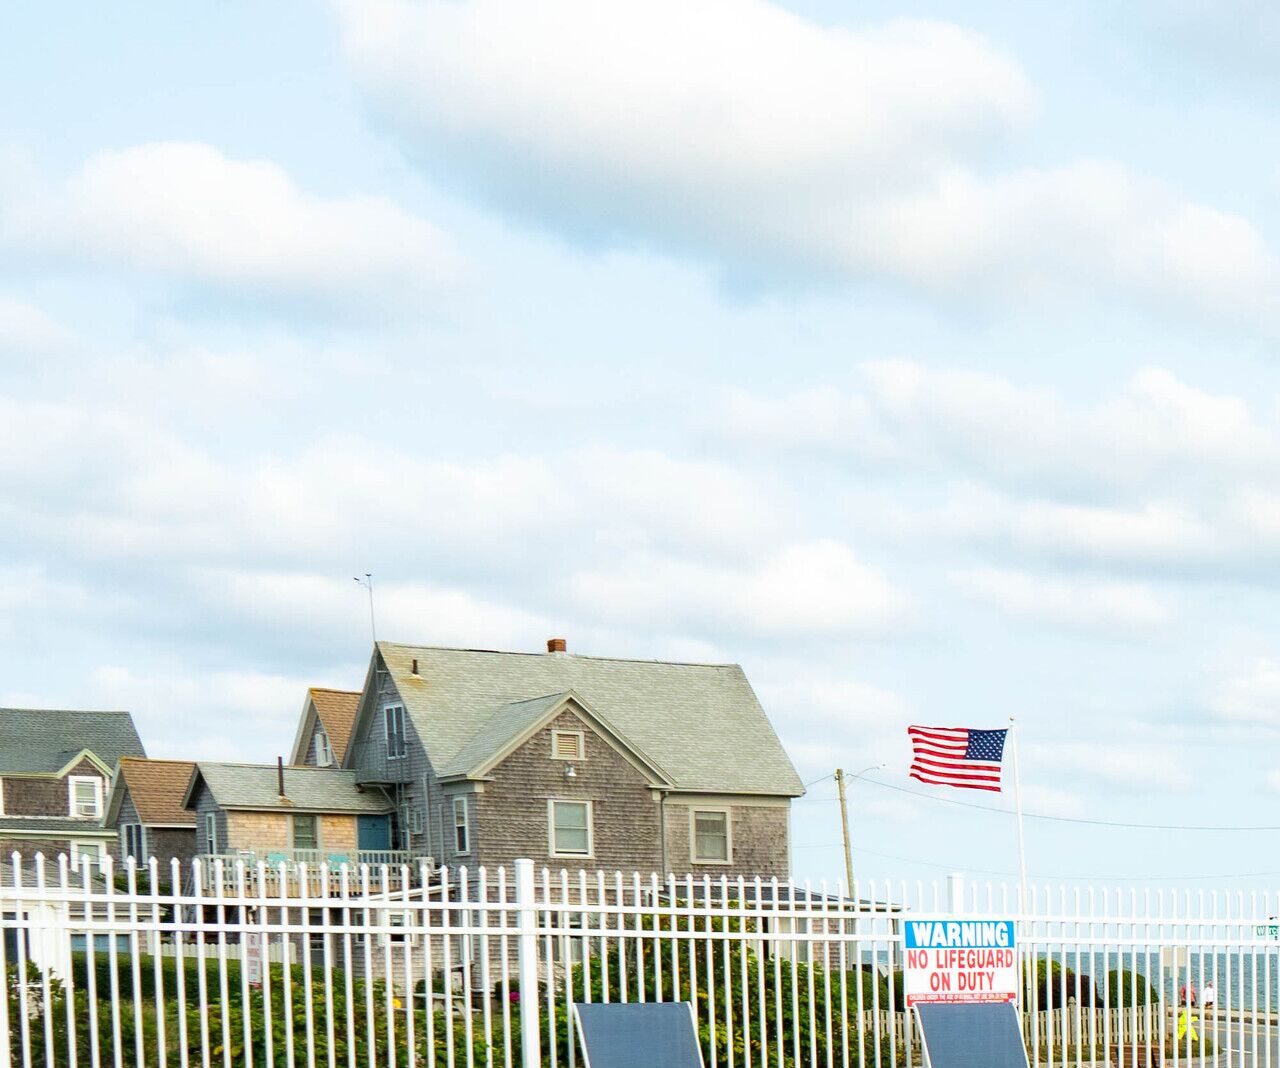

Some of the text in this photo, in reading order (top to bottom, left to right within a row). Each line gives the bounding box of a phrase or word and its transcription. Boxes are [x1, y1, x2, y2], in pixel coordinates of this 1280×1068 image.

[912, 922, 1008, 947] WARNING
[908, 949, 1013, 969] NO LIFEGUARD
[930, 971, 994, 991] ON DUTY
